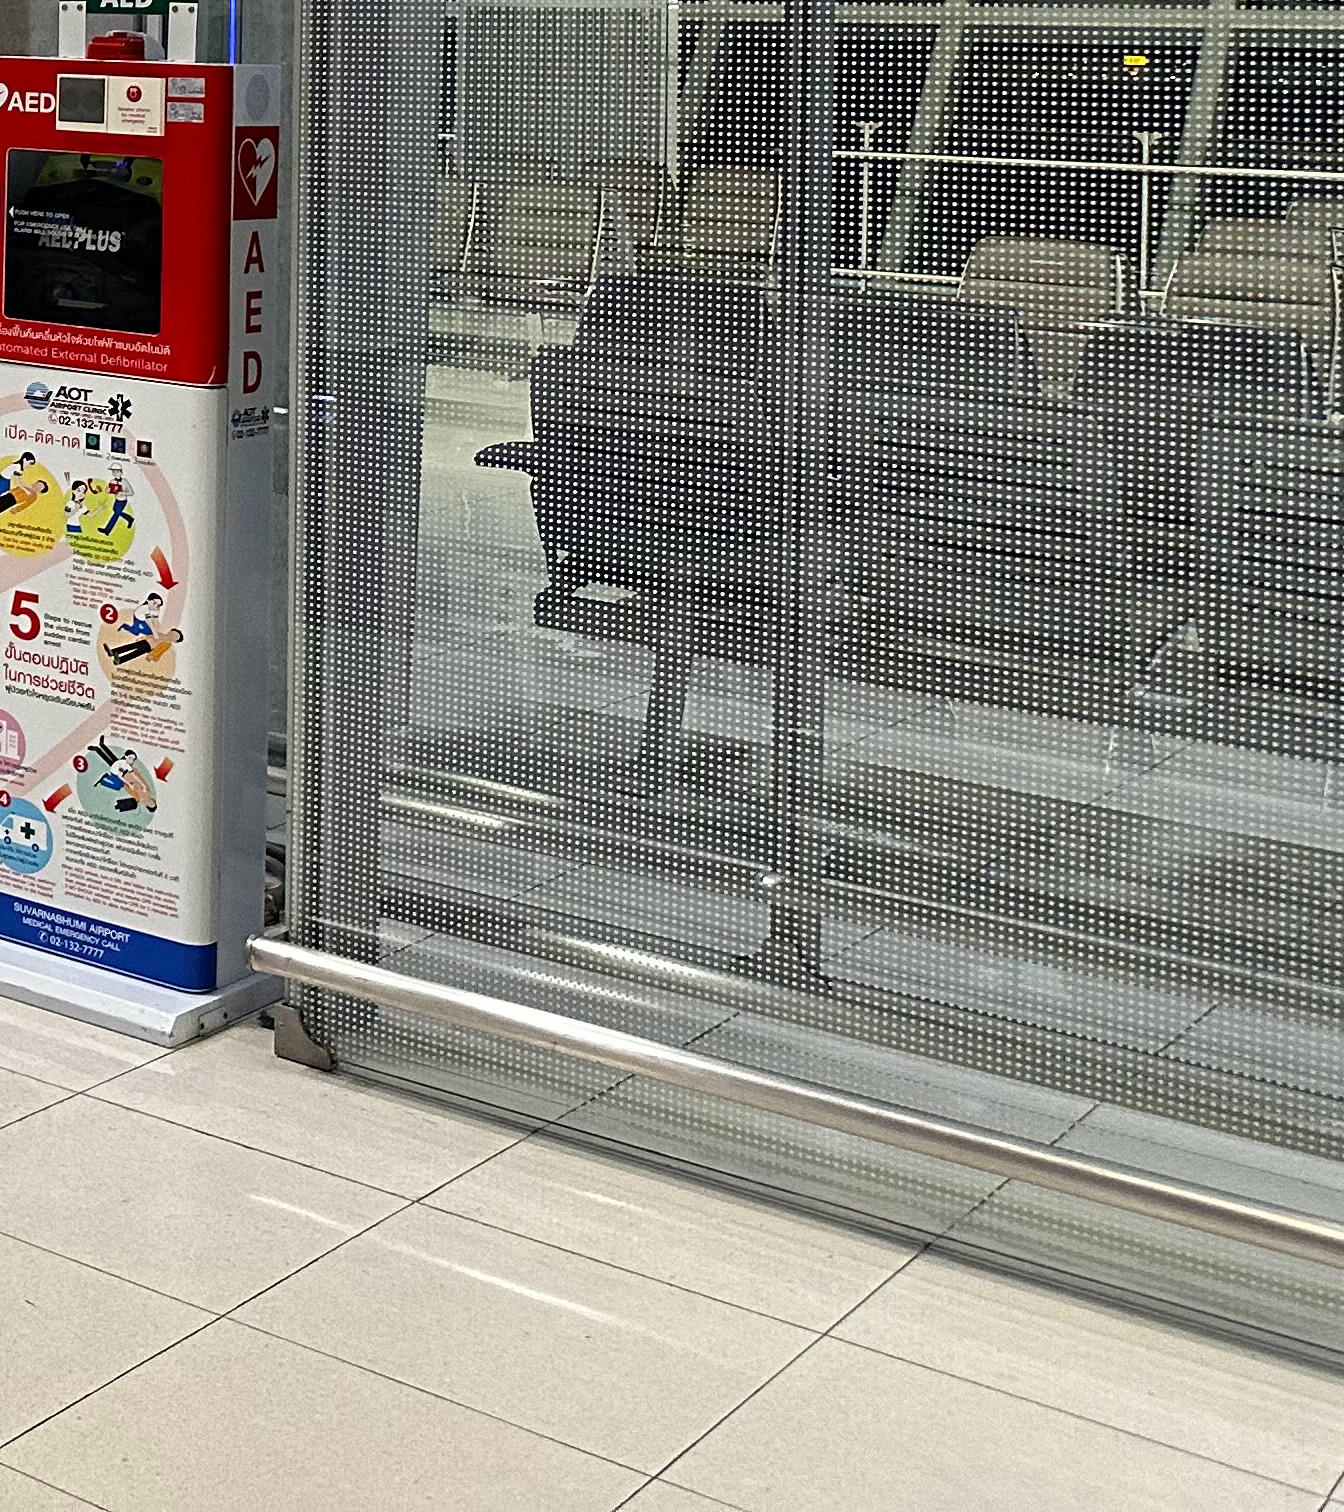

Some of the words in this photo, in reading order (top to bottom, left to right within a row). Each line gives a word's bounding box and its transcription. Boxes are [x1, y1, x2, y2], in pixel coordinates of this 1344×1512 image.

[8, 92, 56, 114] AED
[51, 347, 97, 364] External
[100, 353, 168, 373] Defibrillator
[55, 385, 93, 402] AOT
[58, 415, 123, 434] 02-132-7777
[9, 590, 41, 641] 5
[105, 607, 114, 620] 2
[76, 758, 85, 770] 3
[0, 793, 9, 805] 4
[13, 901, 87, 931] SUVARNABHUMI
[88, 924, 131, 943] AIRPORT
[22, 916, 54, 933] MEDICAL
[101, 937, 121, 952] CALL
[49, 935, 105, 959] 02-132-7777
